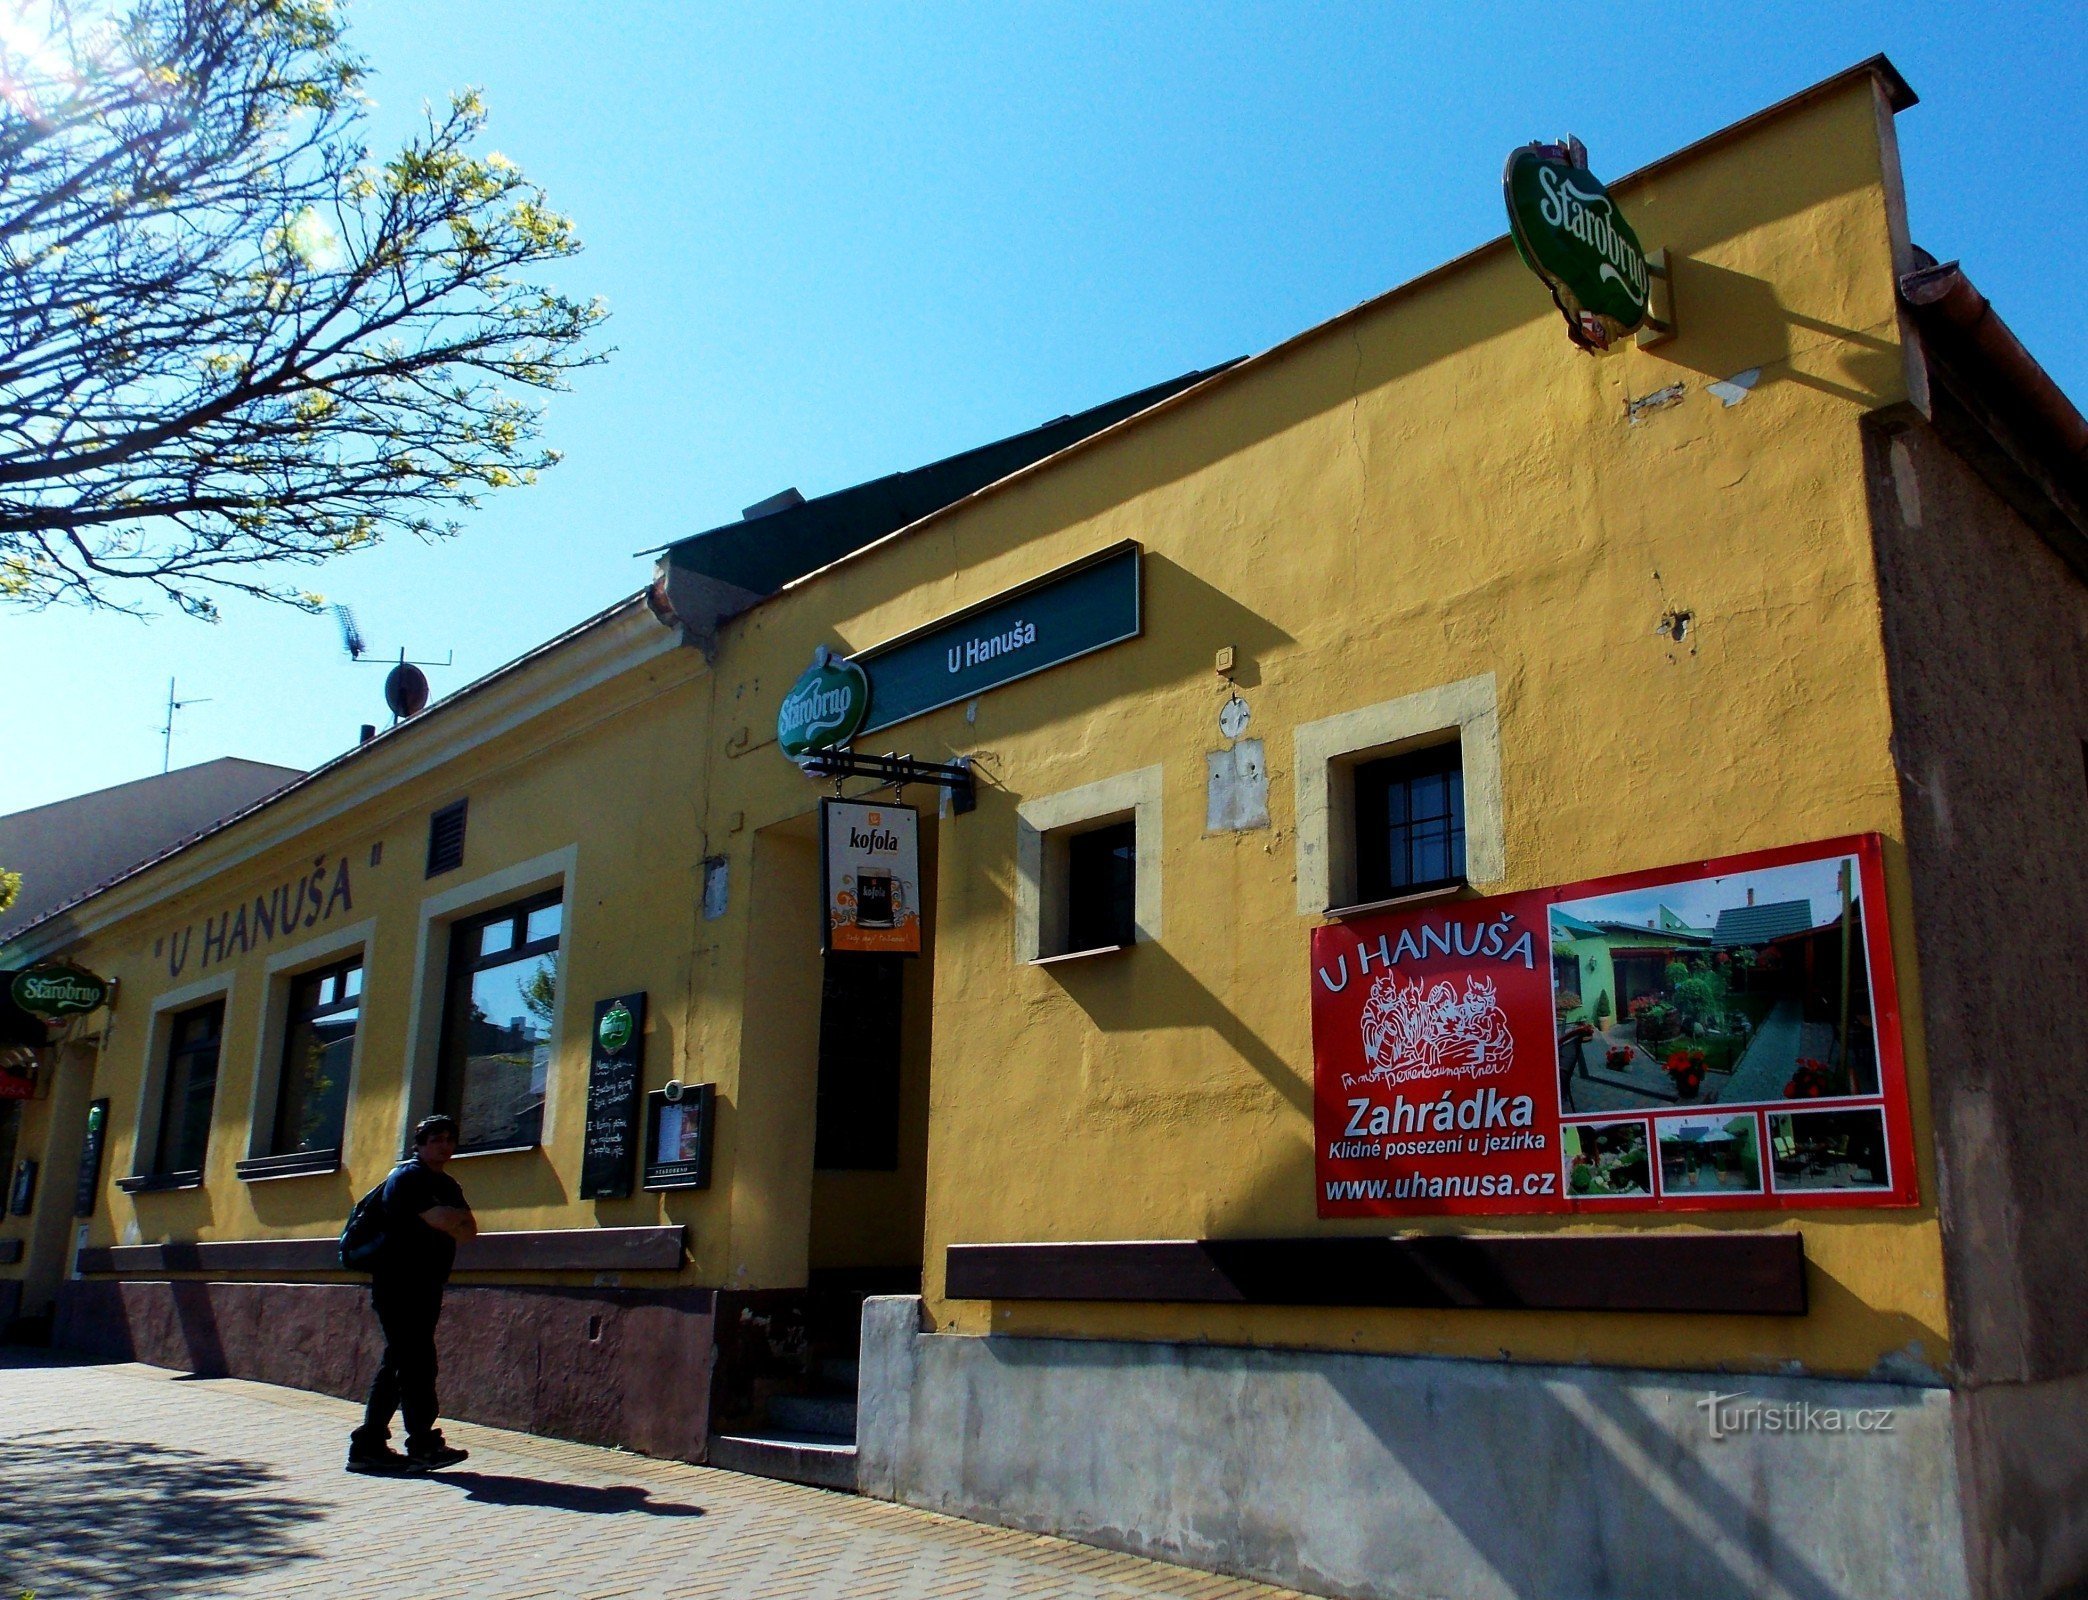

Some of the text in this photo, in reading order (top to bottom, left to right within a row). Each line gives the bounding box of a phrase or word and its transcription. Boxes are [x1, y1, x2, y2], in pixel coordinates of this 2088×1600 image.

[1539, 166, 1648, 306] Starobrno
[948, 619, 1037, 674] U Hanuša
[780, 677, 852, 740] Starobrno
[849, 826, 898, 855] kofola
[1319, 911, 1535, 992] U HANUŠA
[24, 976, 100, 1008] Starobrno
[1344, 1087, 1534, 1137] Zahrádka
[1328, 1131, 1546, 1160] Klidné posezení u jezírka
[1325, 1171, 1556, 1201] www.uhanusa.cz
